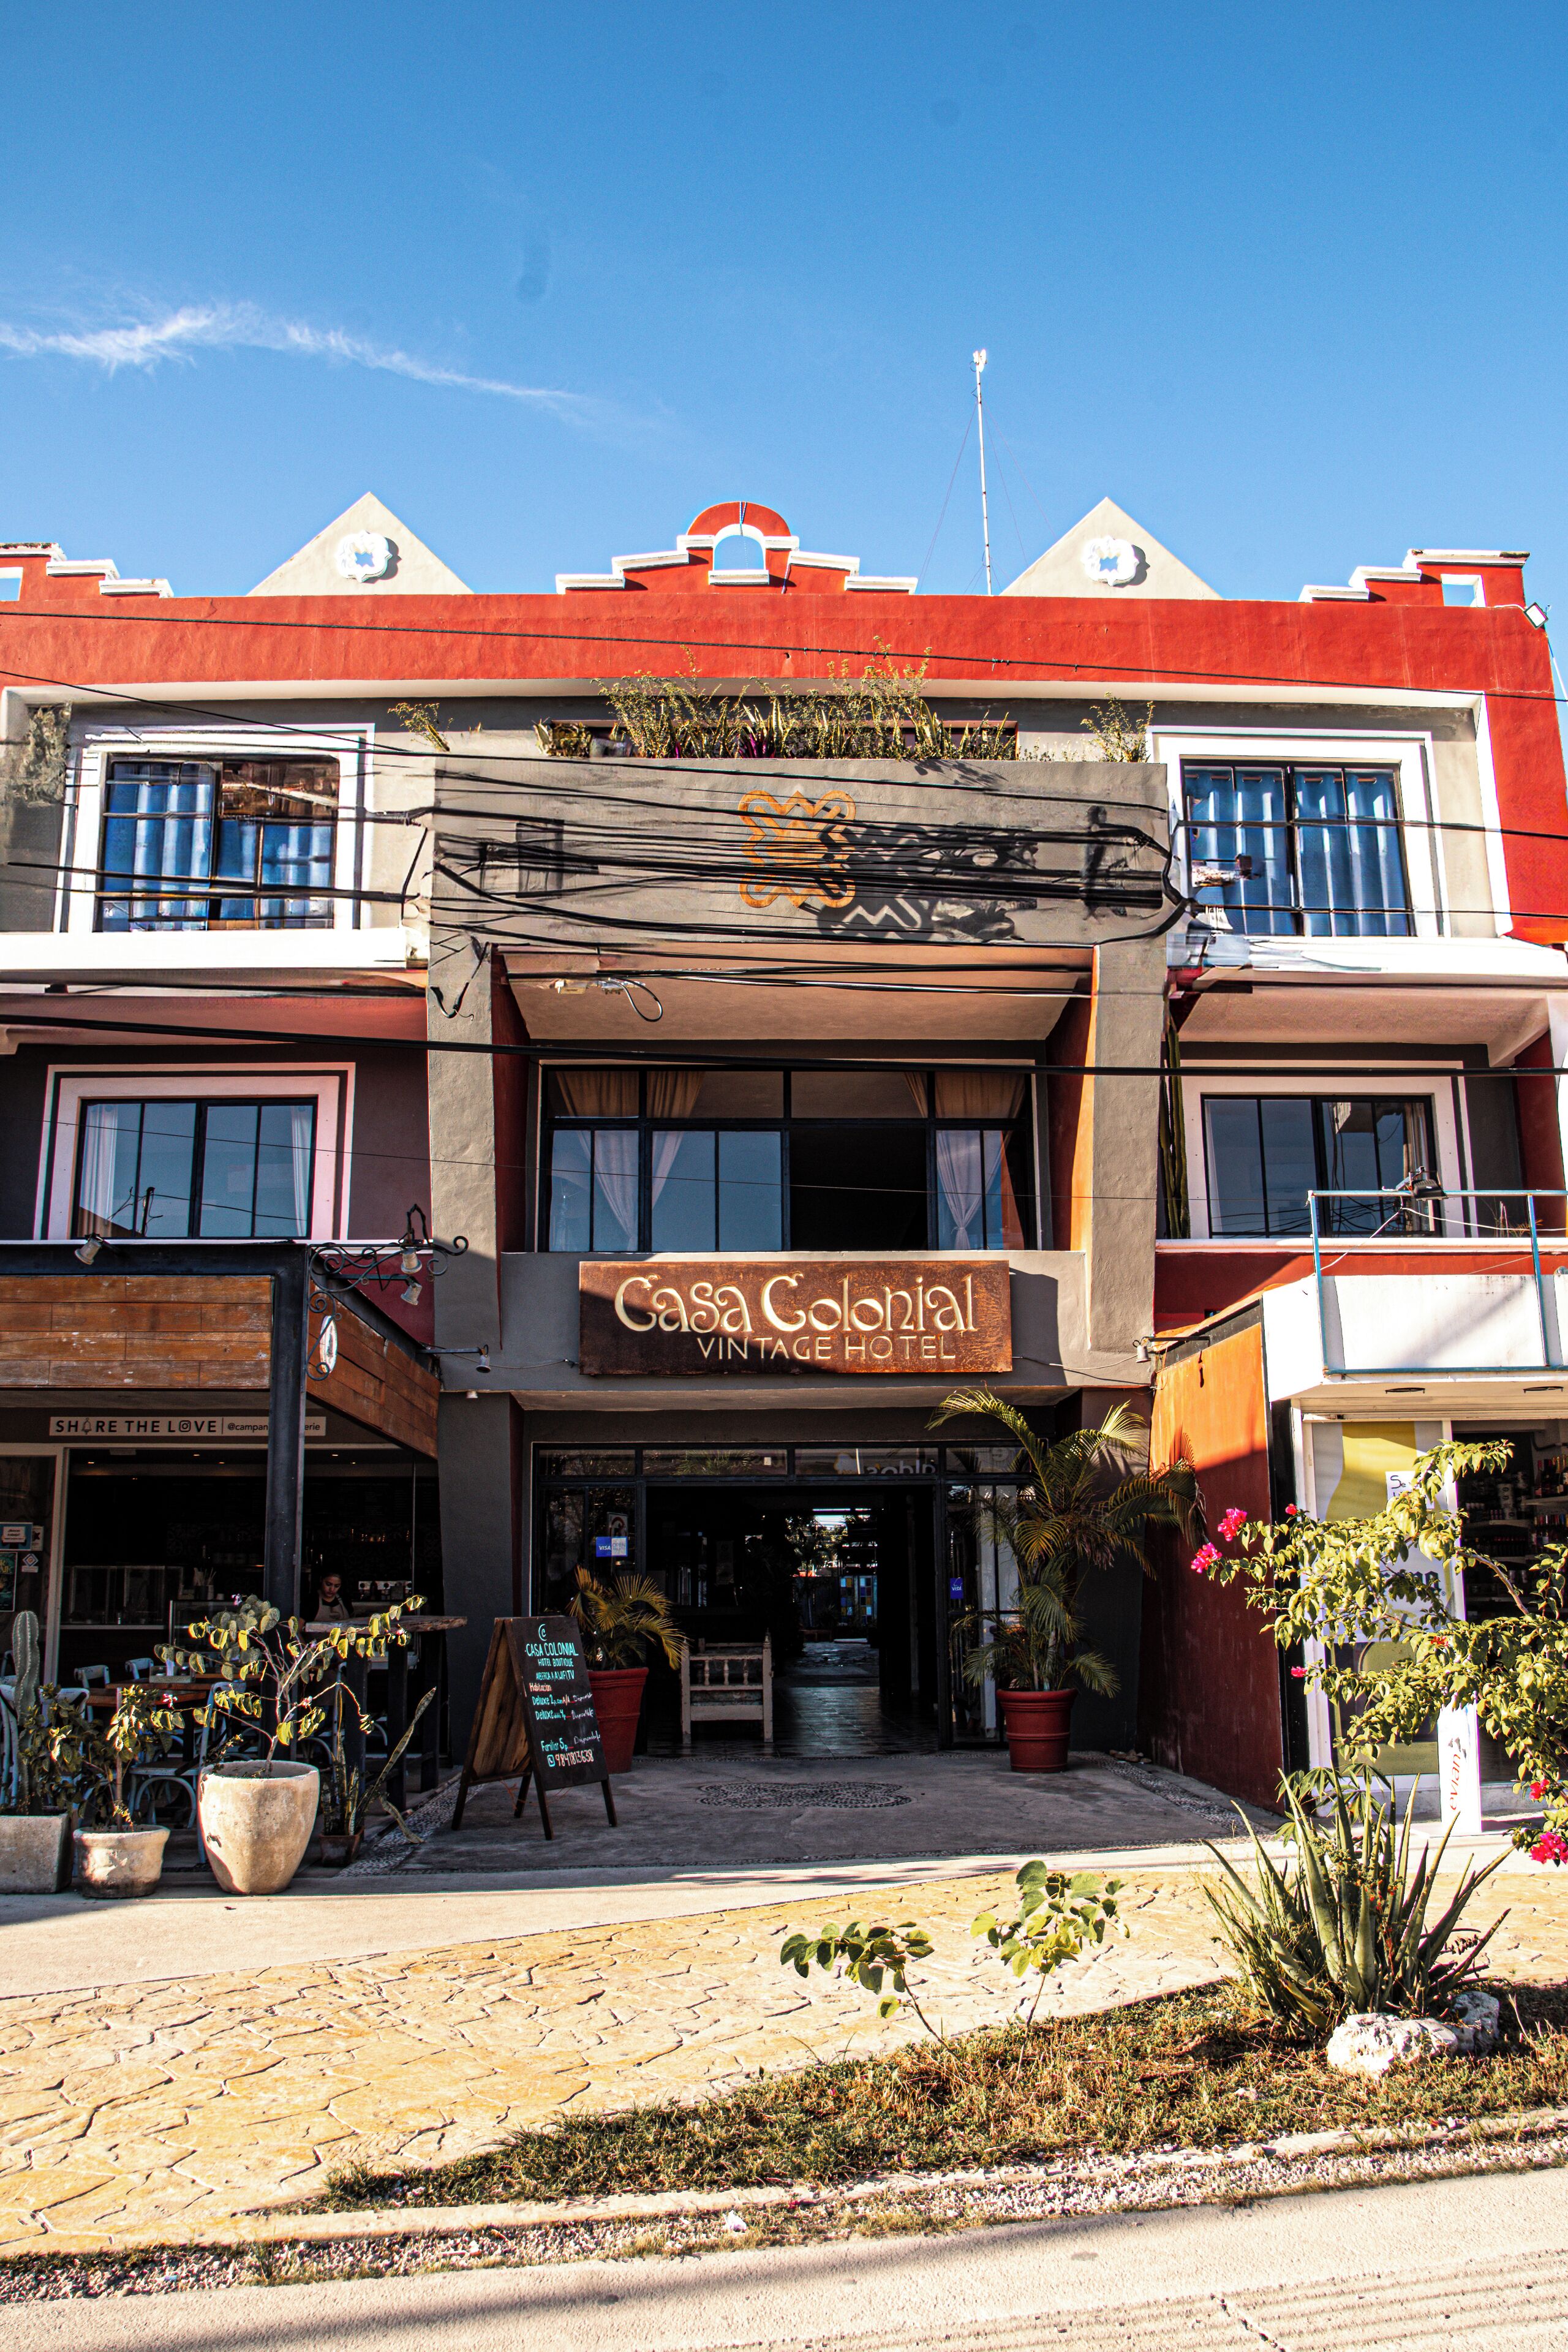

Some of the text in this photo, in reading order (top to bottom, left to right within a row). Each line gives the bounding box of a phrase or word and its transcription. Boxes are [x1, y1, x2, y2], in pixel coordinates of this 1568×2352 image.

[614, 1272, 978, 1333] Casa Colonial
[696, 1335, 956, 1360] VINTAGE HOTEL
[125, 1420, 160, 1433] THE
[526, 1642, 579, 1656] CASA COLONIAL
[552, 1657, 574, 1667] BOUTIQUE
[532, 1695, 549, 1705] Deluxe
[1450, 1754, 1461, 1811] evian
